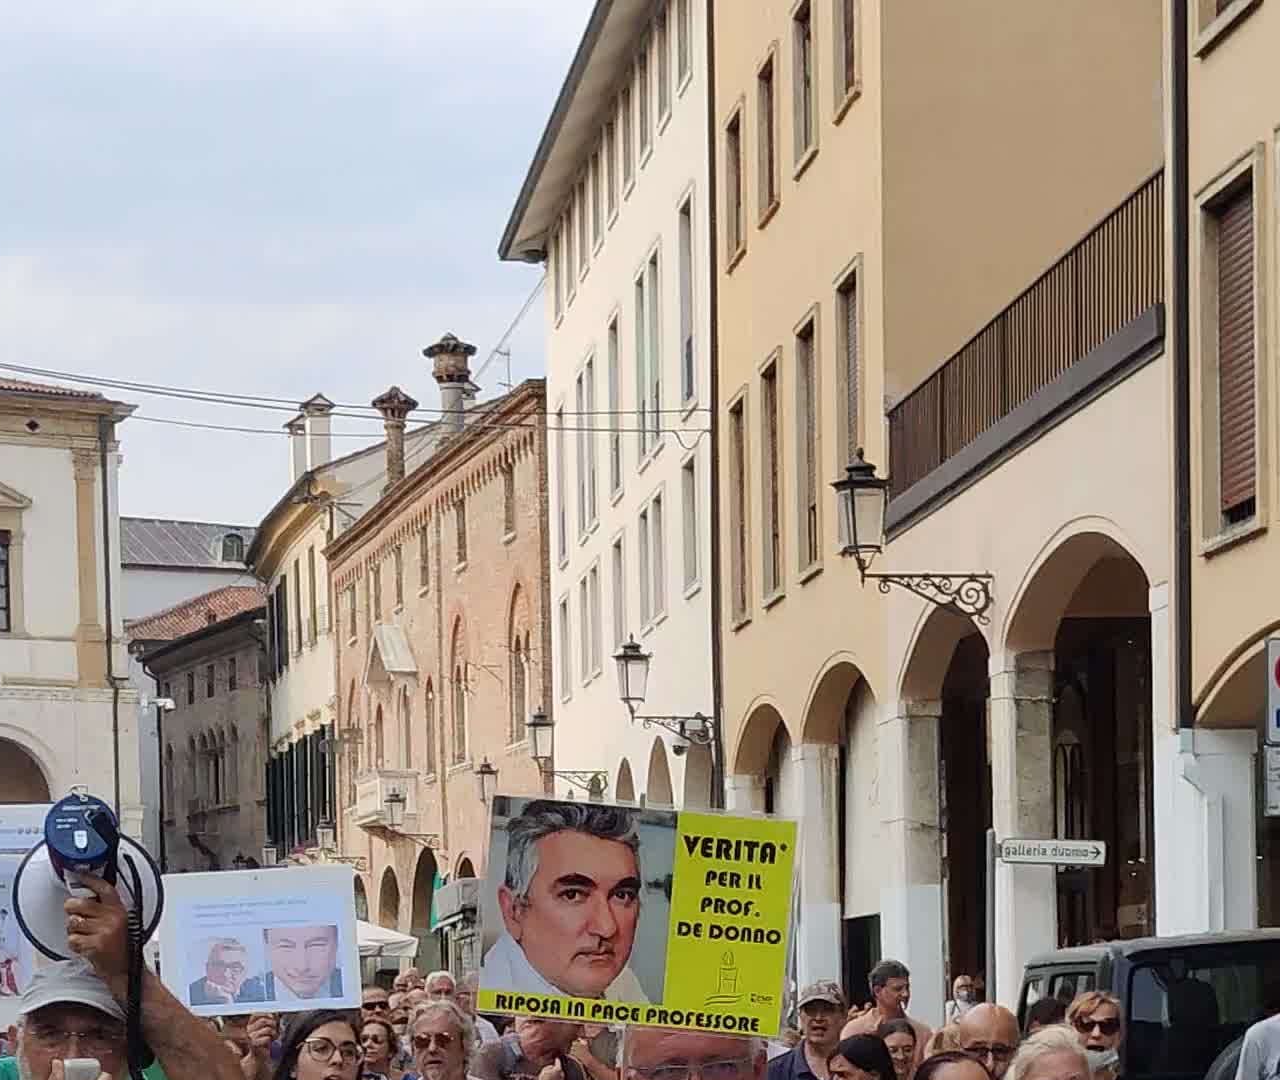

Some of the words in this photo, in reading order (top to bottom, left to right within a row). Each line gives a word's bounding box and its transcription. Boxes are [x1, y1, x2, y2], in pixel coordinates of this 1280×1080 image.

[1004, 843, 1047, 858] galleria
[1050, 844, 1089, 857] duomo
[705, 870, 741, 889] PER
[748, 871, 763, 890] IL
[700, 896, 761, 918] PROF.
[676, 921, 702, 938] DE
[708, 923, 781, 945] DONNO
[495, 993, 561, 1017] RIPOSA
[567, 1000, 585, 1018] IN
[591, 1002, 640, 1023] PACE
[646, 1006, 760, 1033] PROFESSORE
